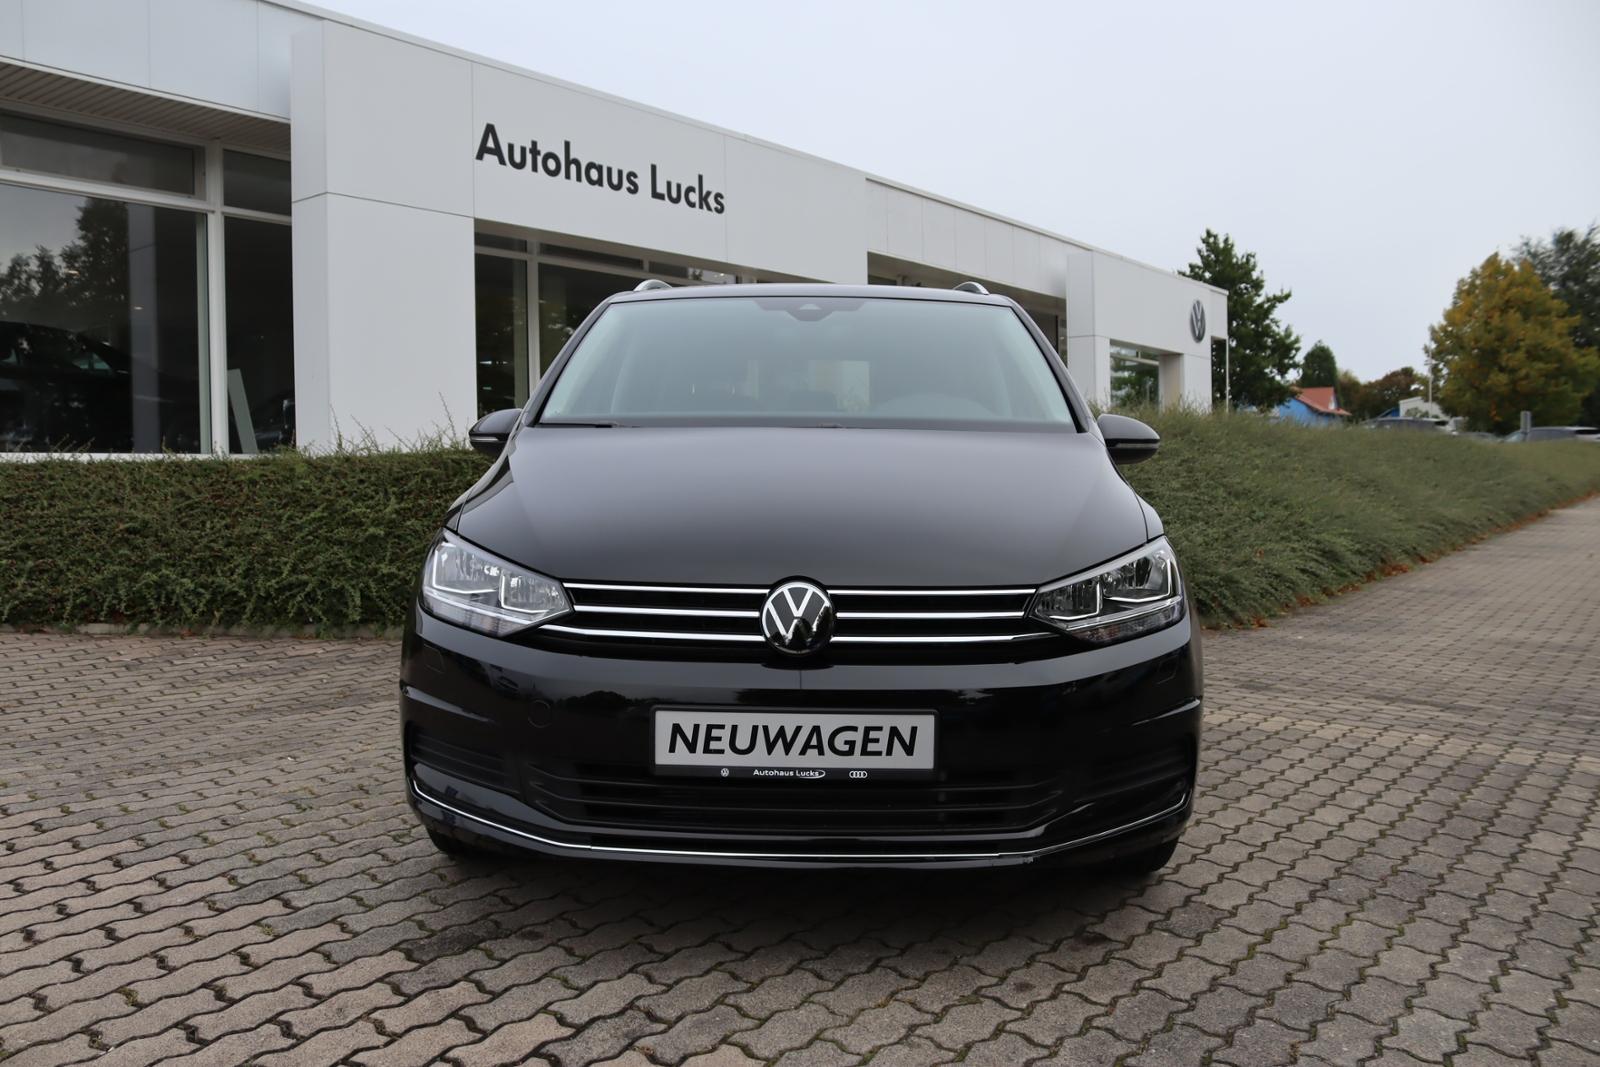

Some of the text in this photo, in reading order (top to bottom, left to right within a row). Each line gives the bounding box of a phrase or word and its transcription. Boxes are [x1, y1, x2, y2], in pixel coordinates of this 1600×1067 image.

[475, 122, 725, 214] Autohaus Lucks
[668, 722, 918, 757] NEUWAGEN
[753, 768, 820, 778] Autohaus Lucks
